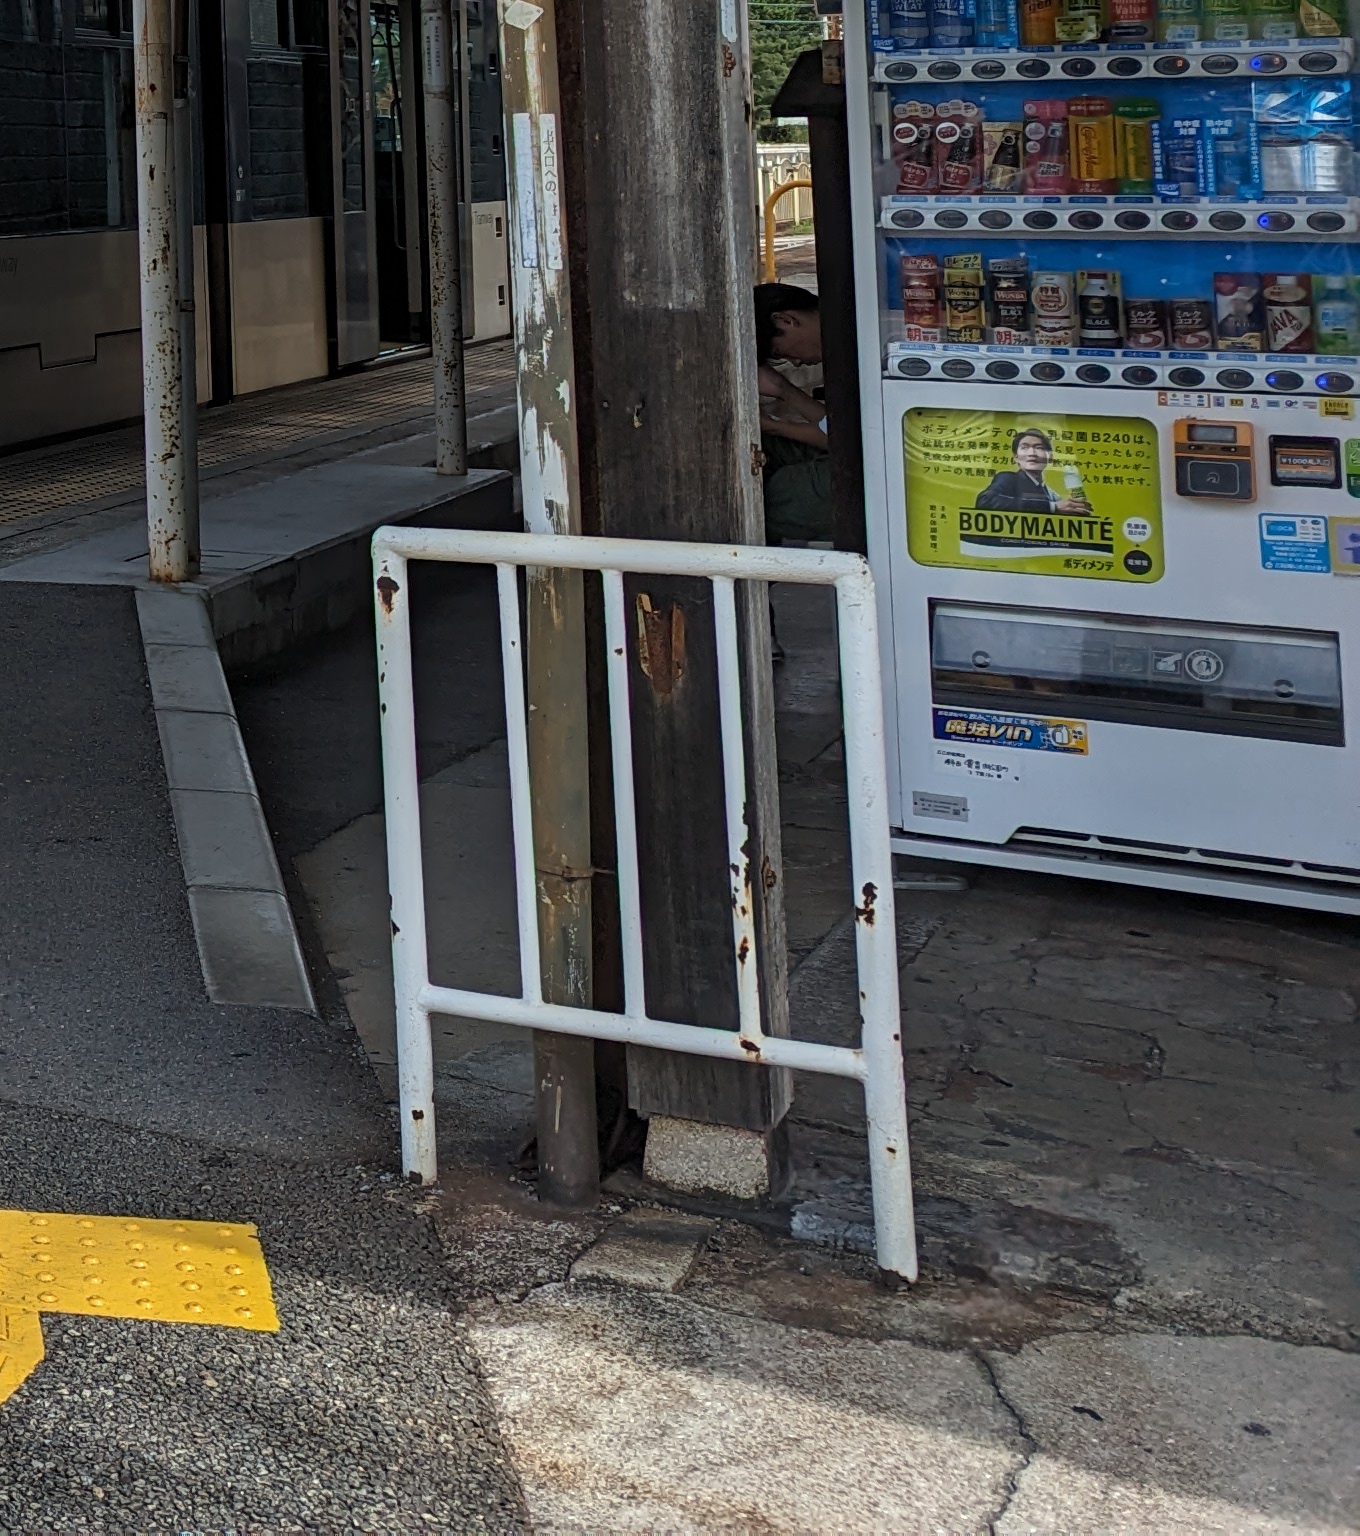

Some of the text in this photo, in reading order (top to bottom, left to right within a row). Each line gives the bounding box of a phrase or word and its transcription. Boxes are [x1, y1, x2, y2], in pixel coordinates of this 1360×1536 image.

[1115, 4, 1148, 15] Value
[906, 328, 922, 341] 朝
[995, 330, 1012, 344] 朝
[921, 424, 1027, 439] ボディメンテの
[959, 511, 1114, 542] BODYMAINTÉ
[1063, 558, 1115, 570] ボディメンテ
